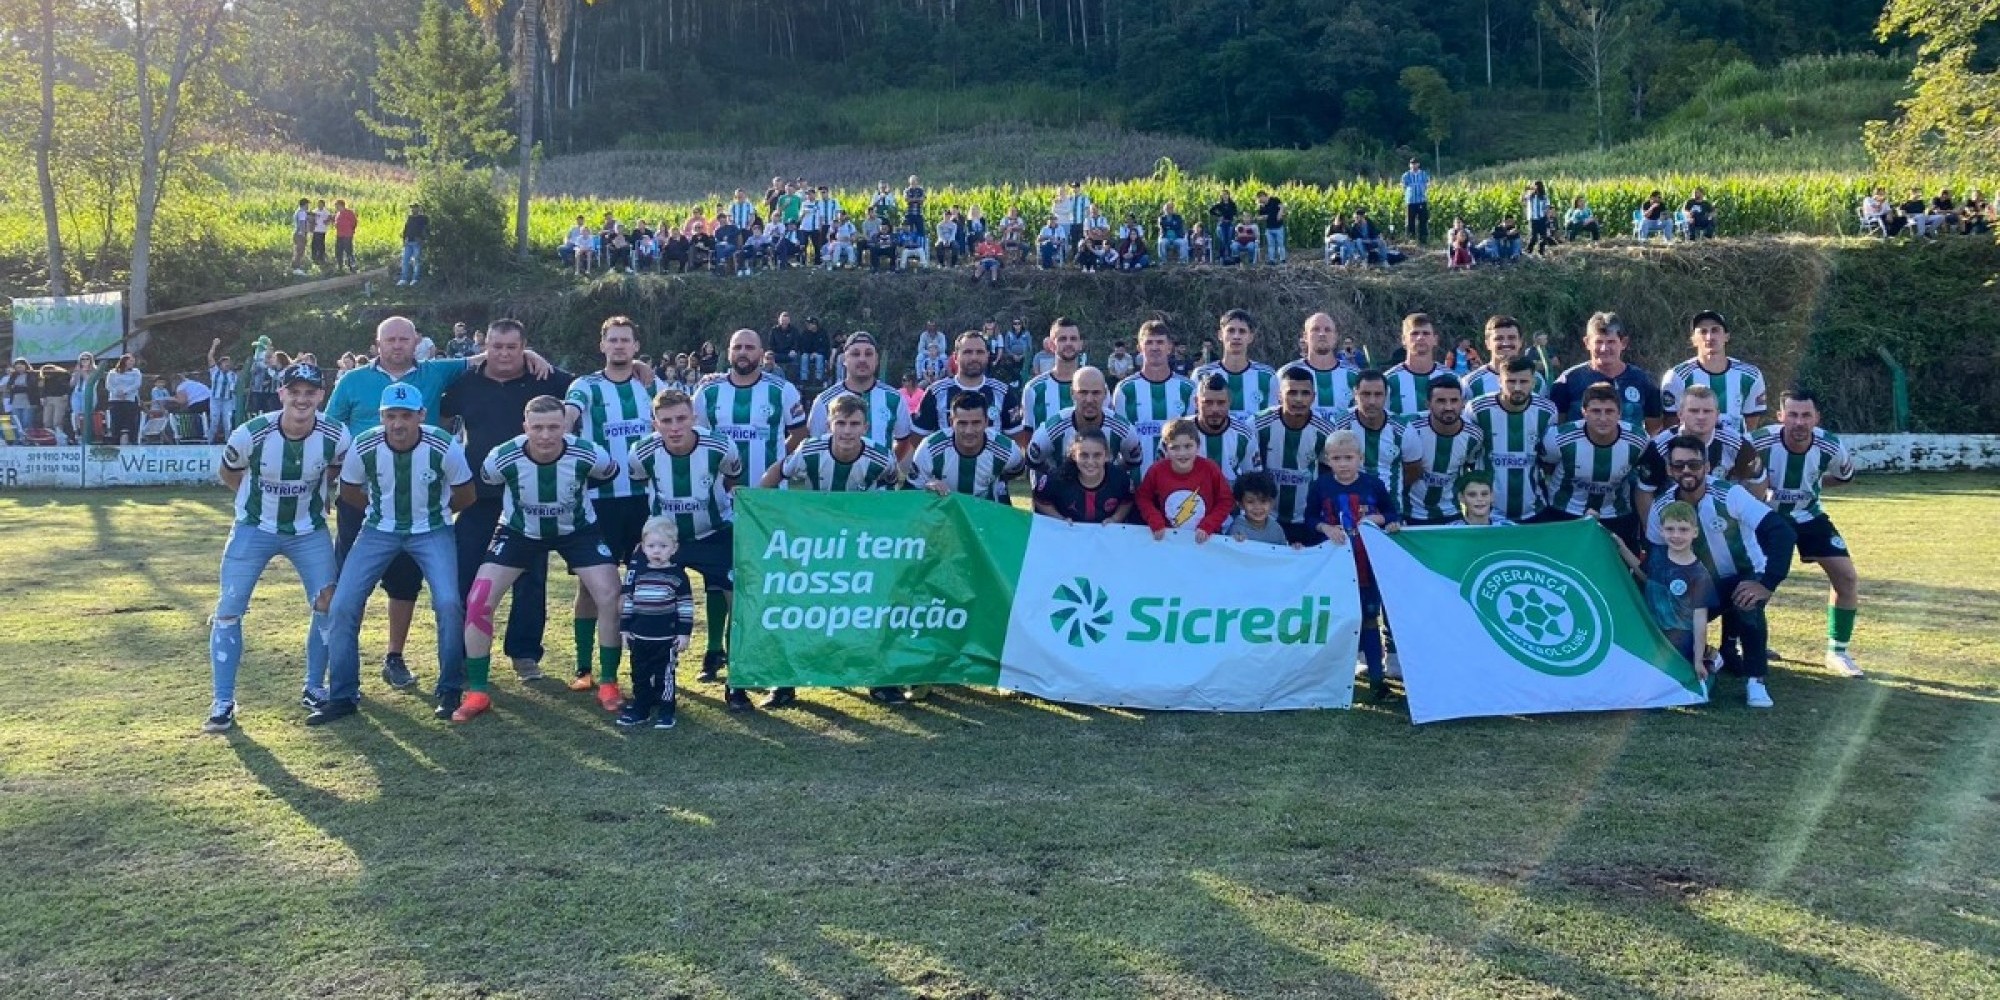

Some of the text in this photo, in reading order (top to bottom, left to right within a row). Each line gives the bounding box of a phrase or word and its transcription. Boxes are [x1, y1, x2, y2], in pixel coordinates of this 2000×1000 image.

[604, 425, 646, 437] POTRICH
[762, 529, 926, 566] Aqui tem
[763, 570, 874, 594] nossa
[1482, 569, 1568, 600] ESPERANÇA
[761, 598, 968, 638] cooperação
[1126, 595, 1331, 645] Sicredi
